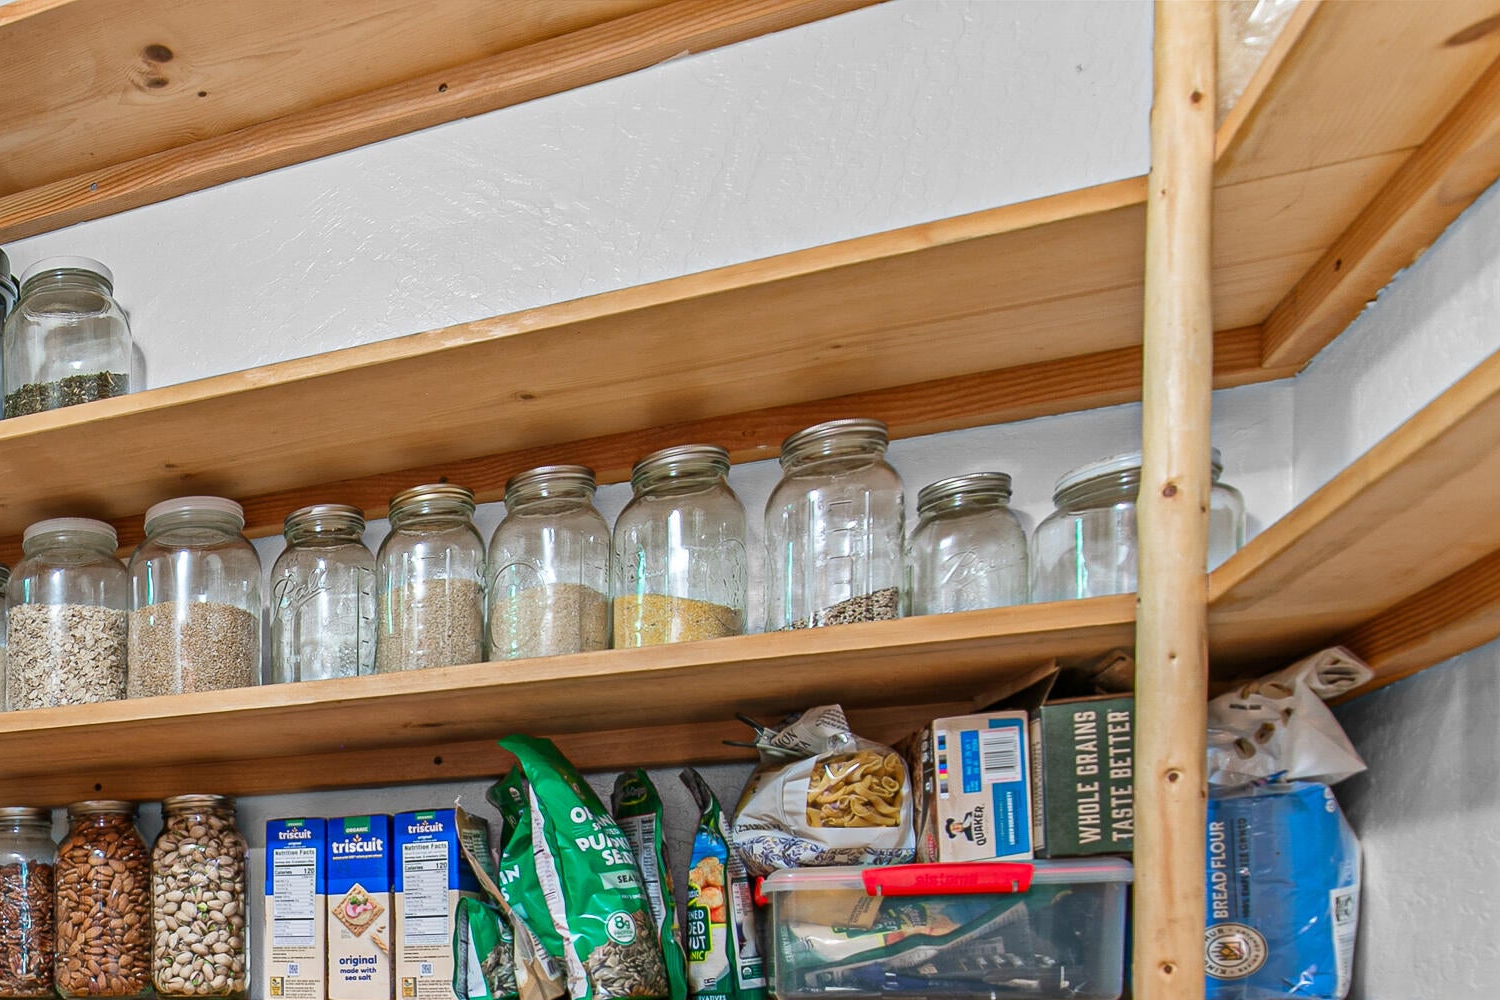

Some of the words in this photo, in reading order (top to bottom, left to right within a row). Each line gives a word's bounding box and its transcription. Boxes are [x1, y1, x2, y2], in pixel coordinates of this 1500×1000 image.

[1073, 710, 1099, 776] GRAINS
[1107, 711, 1133, 778] BETTER
[278, 830, 311, 840] triscuit
[407, 823, 443, 834] triscuit
[973, 805, 987, 846] QUAKER
[1077, 781, 1101, 844] WHOLE
[1109, 782, 1134, 841] TASTE
[331, 837, 384, 855] triscuit
[1209, 821, 1227, 868] FLOUR
[1212, 872, 1229, 919] BREAD
[339, 954, 377, 968] original
